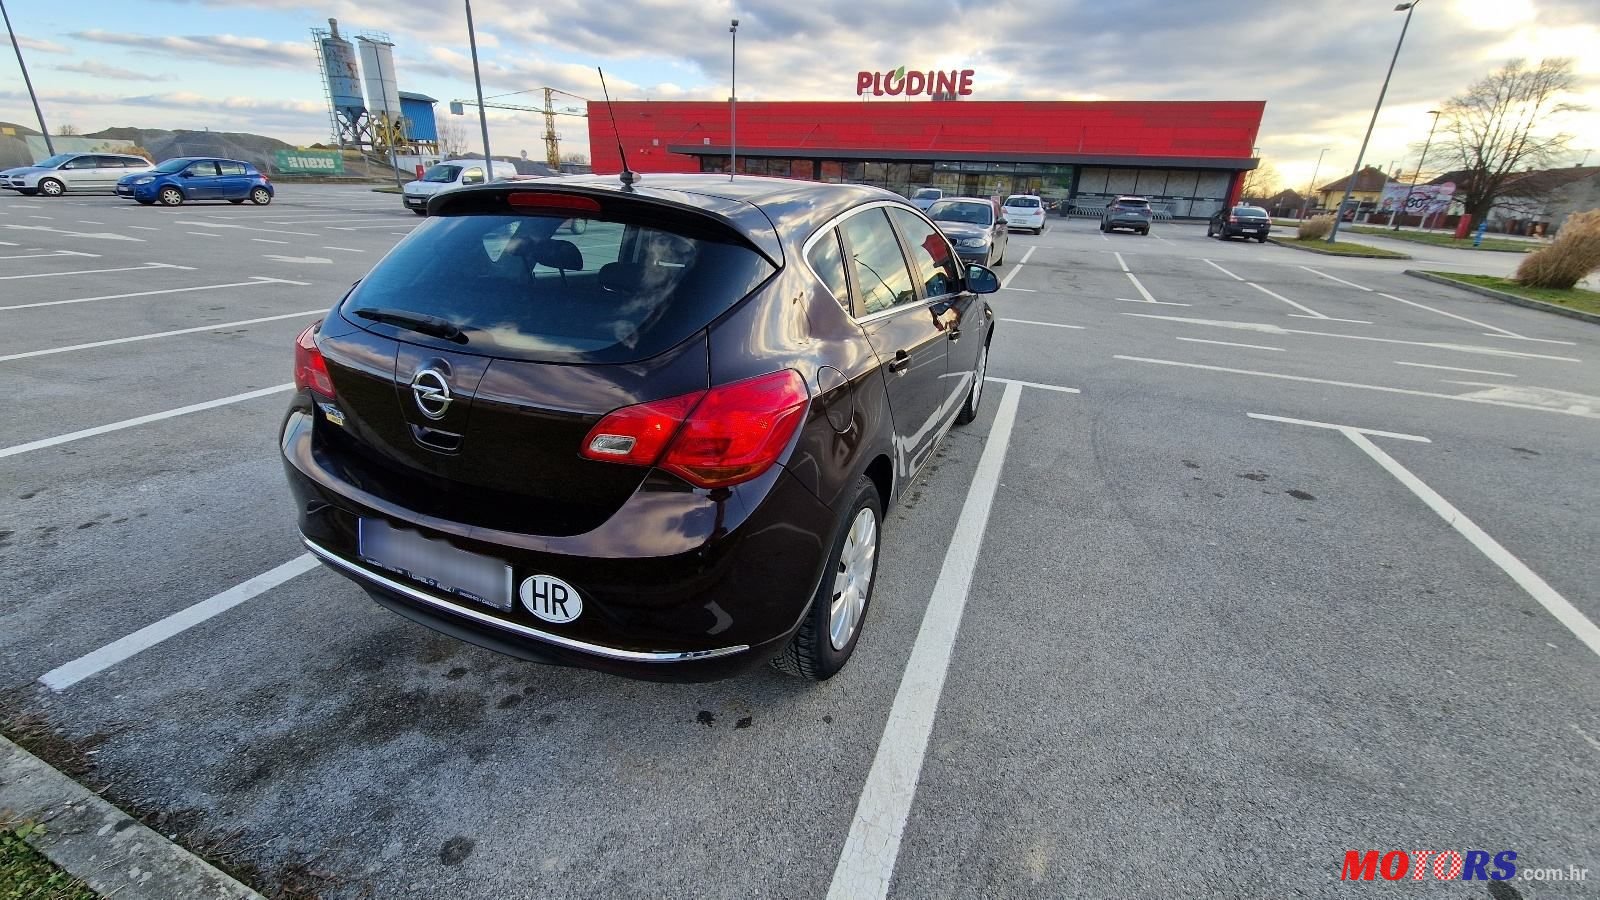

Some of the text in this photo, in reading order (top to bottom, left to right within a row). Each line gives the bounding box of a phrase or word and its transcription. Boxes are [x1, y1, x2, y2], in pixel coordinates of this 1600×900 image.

[857, 69, 975, 96] PLODINE
[297, 157, 335, 169] nexe
[532, 579, 569, 618] HR
